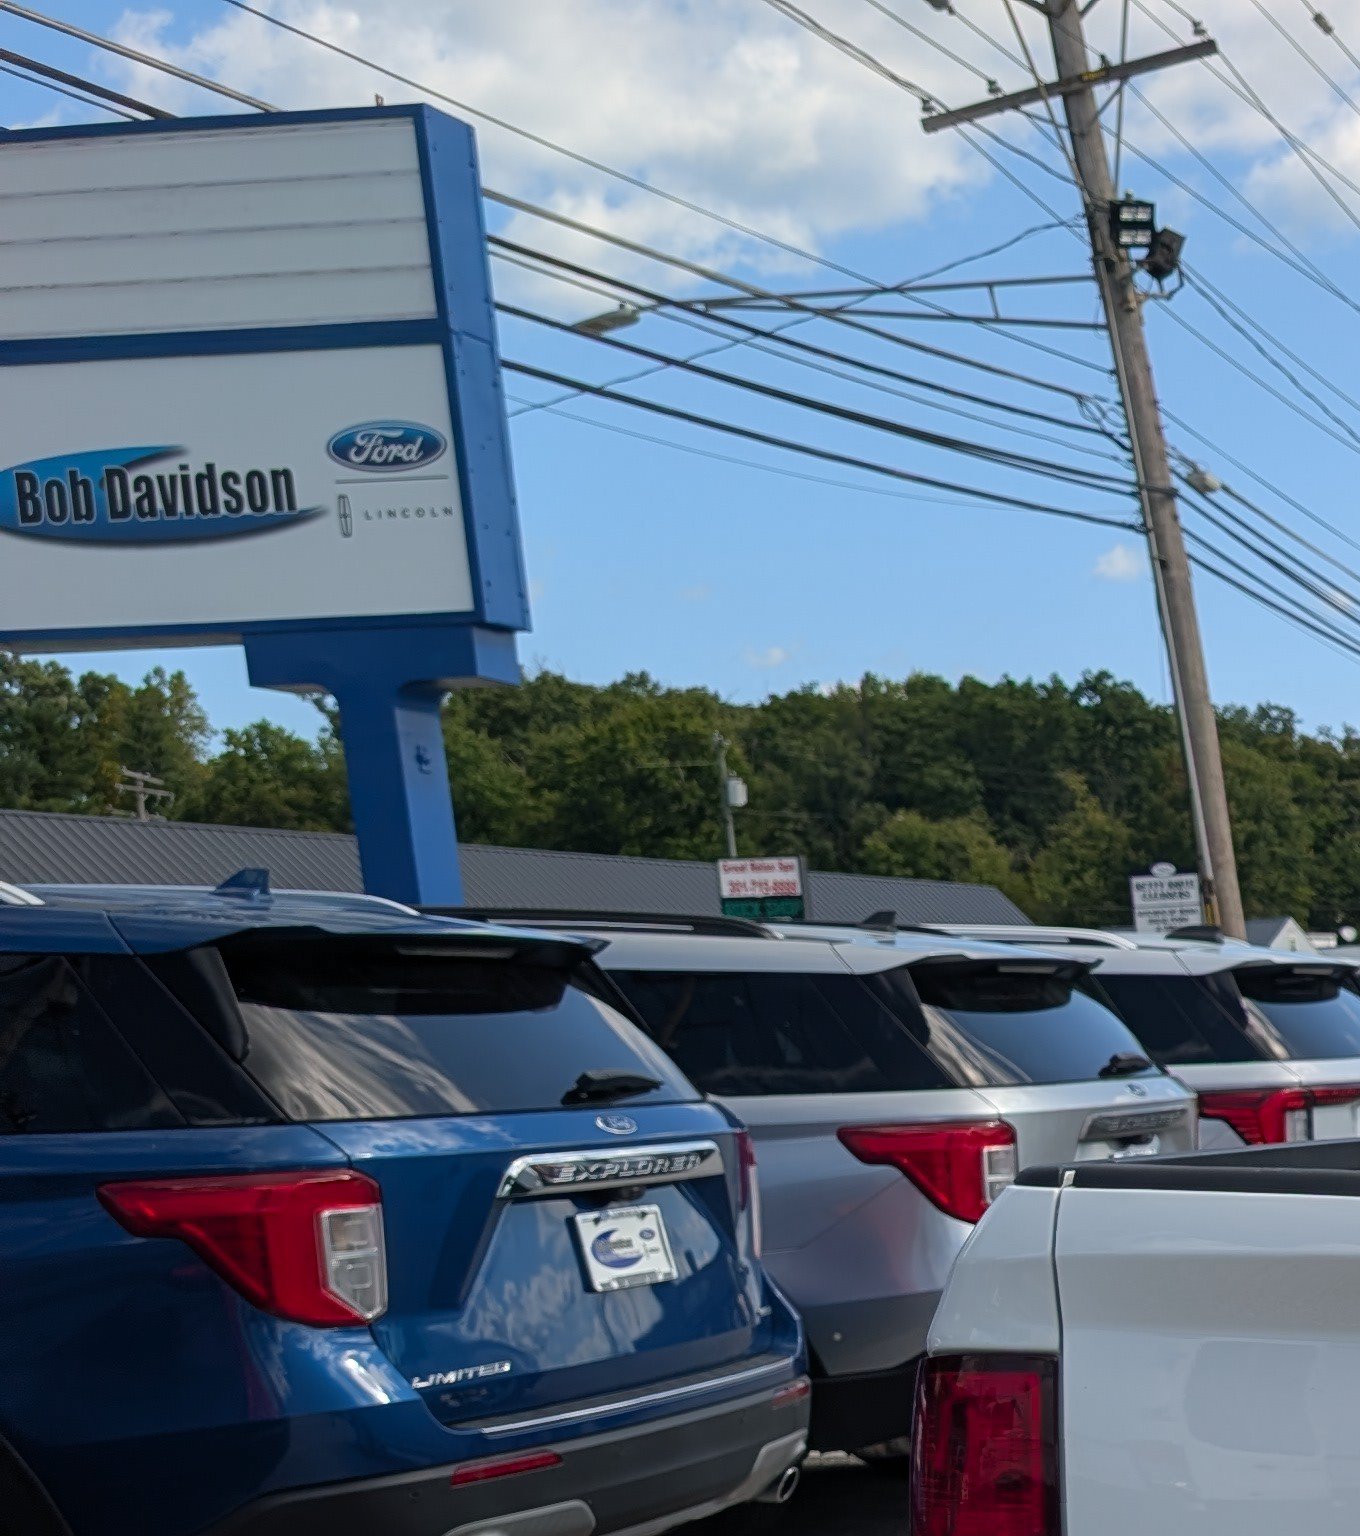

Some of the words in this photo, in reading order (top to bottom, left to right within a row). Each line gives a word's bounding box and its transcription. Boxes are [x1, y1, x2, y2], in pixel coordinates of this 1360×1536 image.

[348, 428, 424, 466] Ford
[15, 468, 93, 526] Bob
[105, 463, 298, 522] Davidson
[364, 505, 455, 521] LINCOLN
[551, 1153, 701, 1184] EXPLORER
[411, 1360, 511, 1389] LIMITED
